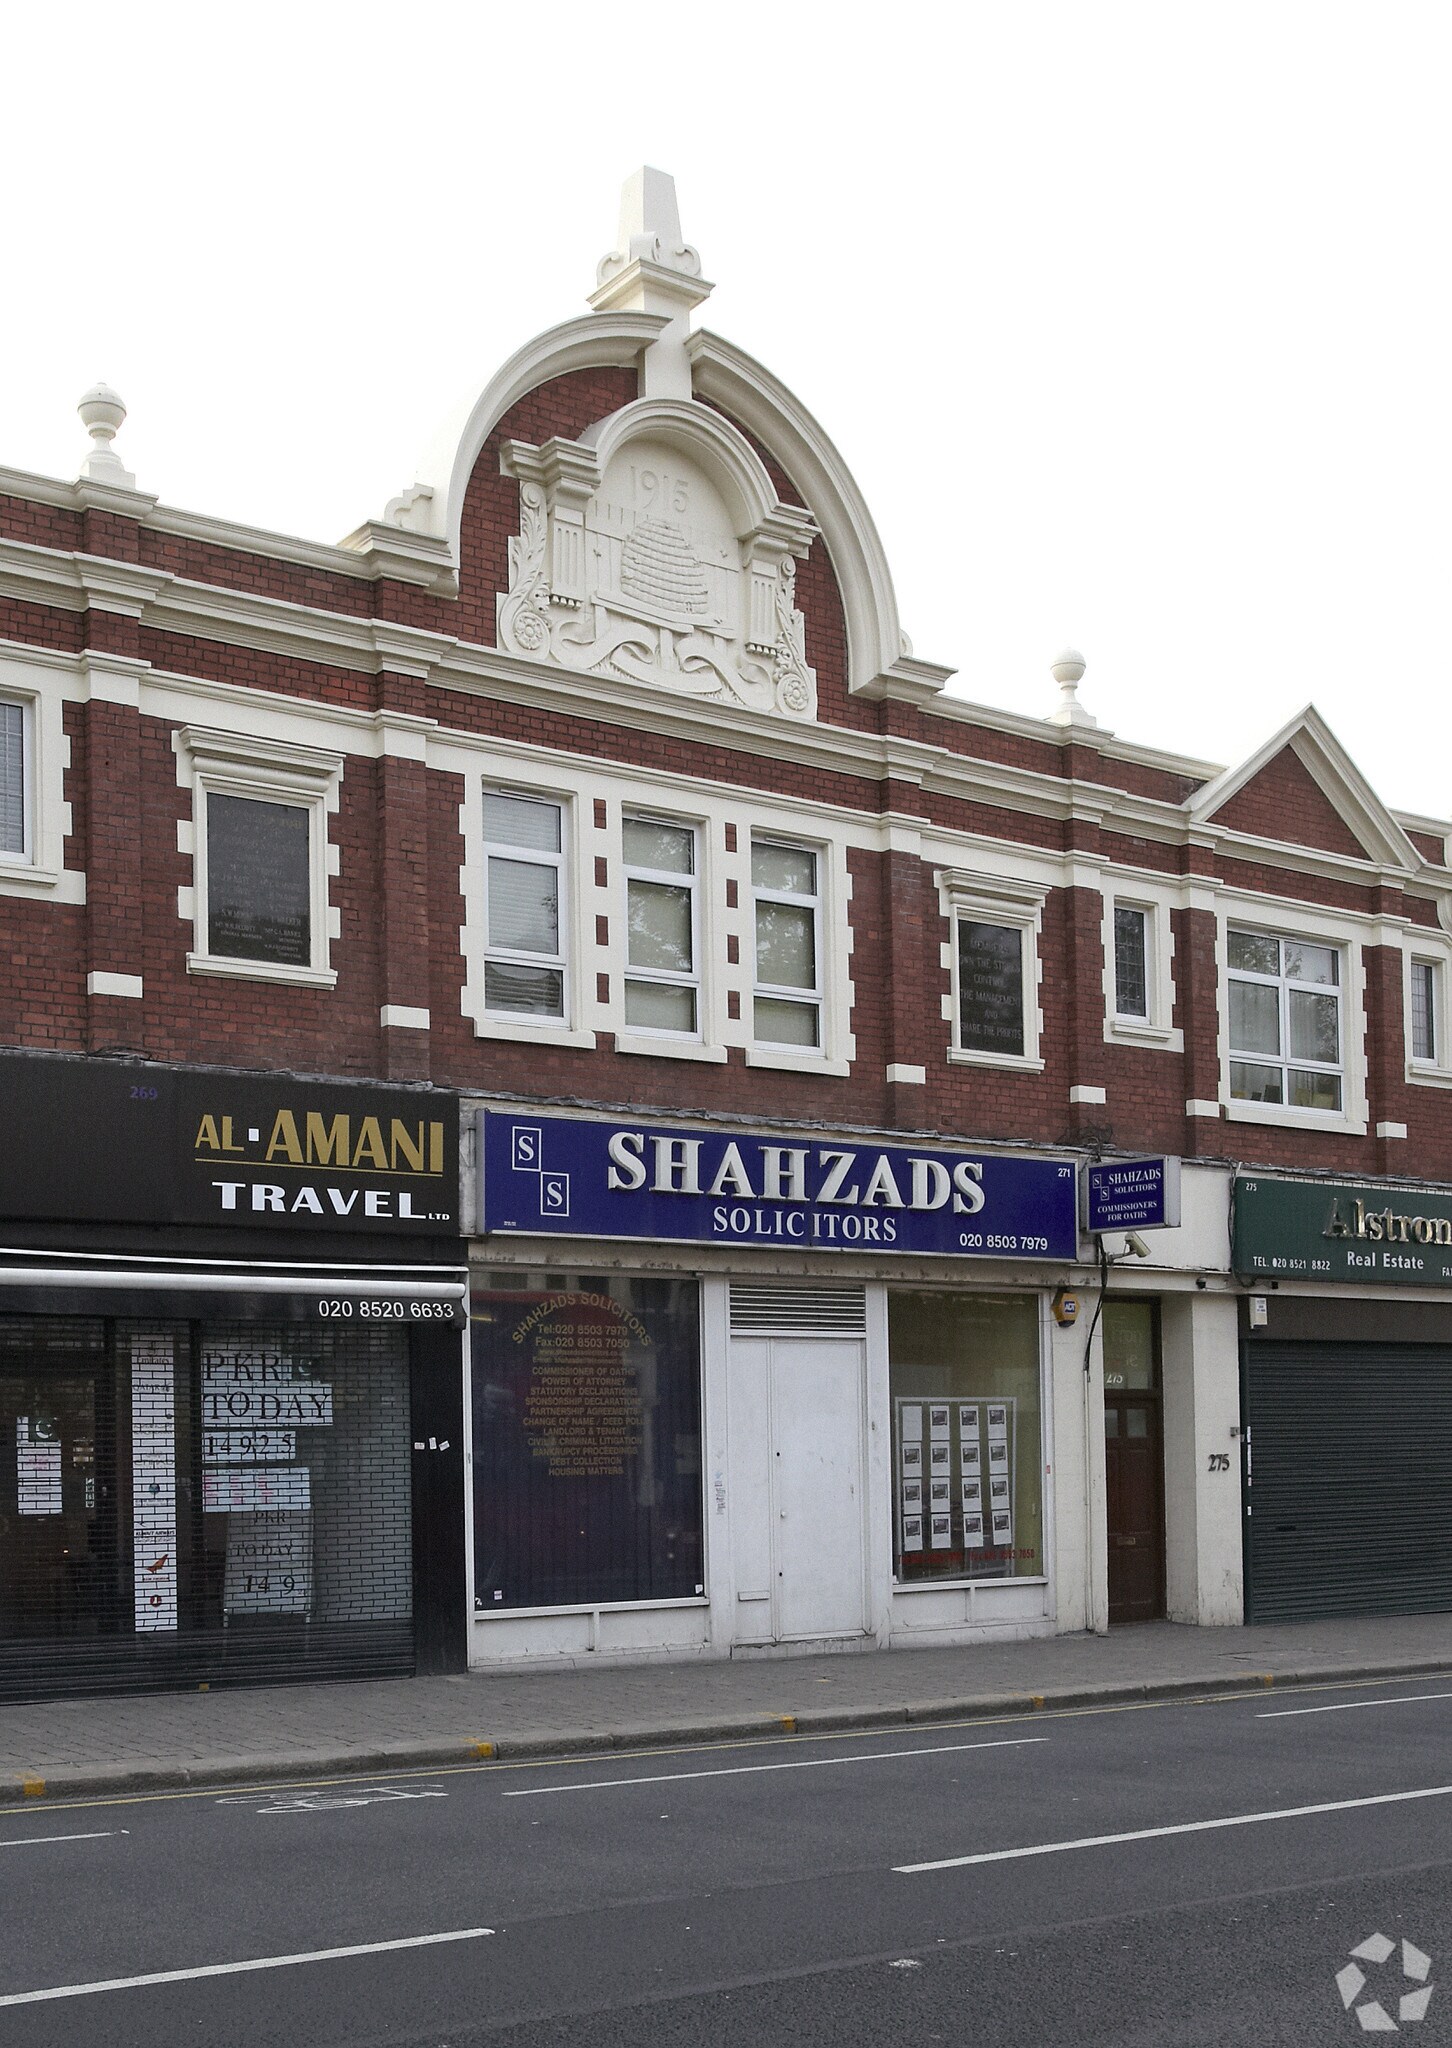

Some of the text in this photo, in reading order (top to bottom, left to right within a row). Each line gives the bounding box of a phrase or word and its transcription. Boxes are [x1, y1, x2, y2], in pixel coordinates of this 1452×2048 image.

[130, 1086, 158, 1099] 269
[518, 1135, 535, 1161] S
[608, 1131, 986, 1214] SHAHZADS
[1057, 1167, 1071, 1178] 271
[1108, 1168, 1161, 1185] SHAHZADS
[546, 1181, 563, 1207] S
[1114, 1183, 1157, 1194] SOLICITORS
[1245, 1182, 1257, 1191] 275
[212, 1181, 427, 1220] TRAVEL
[1097, 1200, 1157, 1213] COMMISSIONERS
[428, 1212, 451, 1221] LTD
[1107, 1211, 1148, 1221] FOR OATHS
[959, 1233, 1048, 1250] 020 8503 7979
[1272, 1257, 1287, 1268] 020
[1289, 1259, 1306, 1269] 8521
[1311, 1259, 1331, 1271] 8822
[1347, 1250, 1425, 1270] Real Estate
[318, 1300, 454, 1318] 020 8520 6633
[512, 1292, 652, 1347] SHAHZADS SOLICITORS
[577, 1325, 602, 1335] 8503
[605, 1325, 629, 1336] 7979
[577, 1338, 602, 1348] 8503
[606, 1338, 630, 1348] 7050
[203, 1352, 281, 1381] PKR
[203, 1391, 332, 1420] TODAY
[1208, 1453, 1230, 1471] 275
